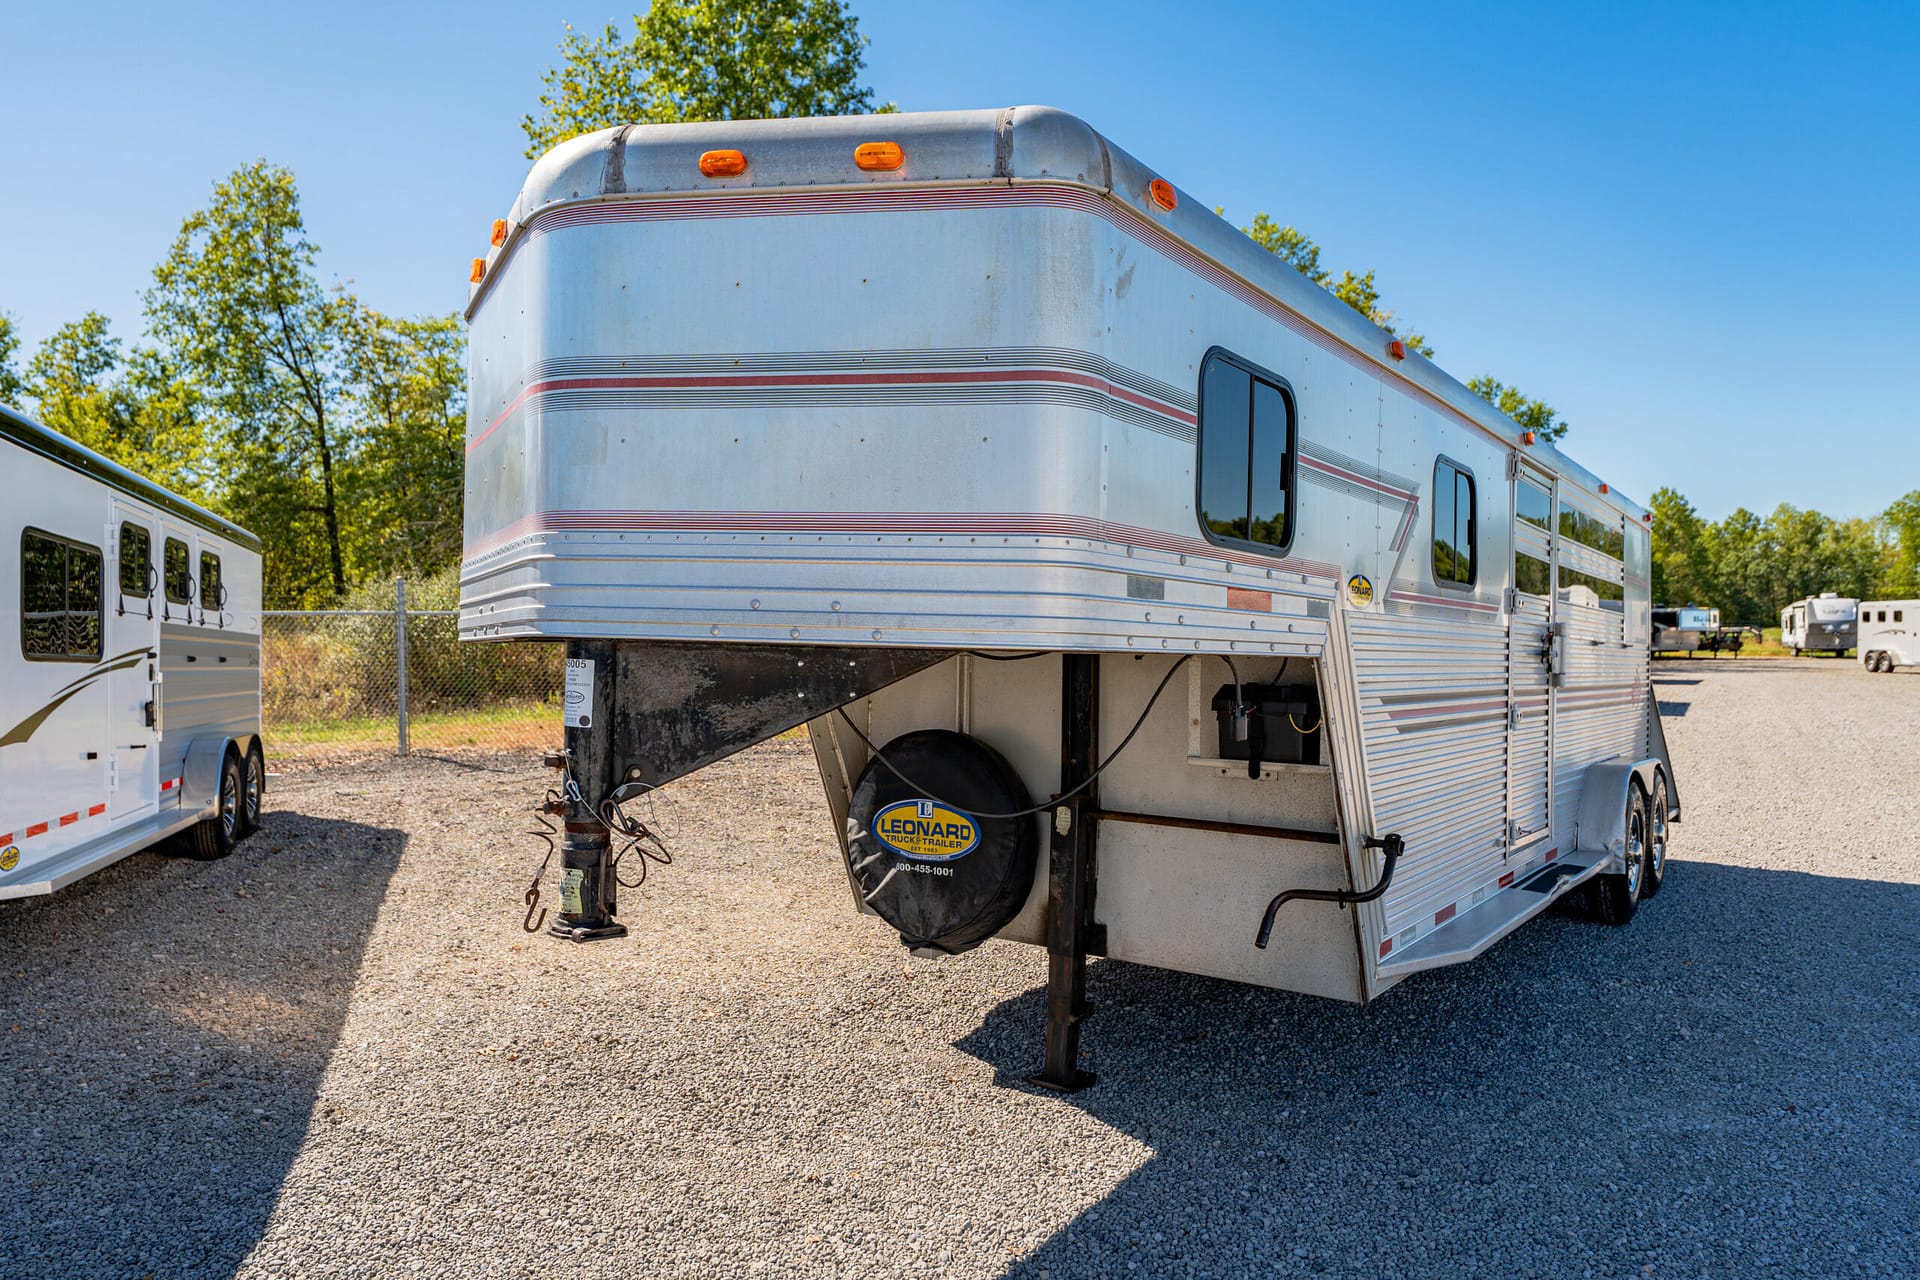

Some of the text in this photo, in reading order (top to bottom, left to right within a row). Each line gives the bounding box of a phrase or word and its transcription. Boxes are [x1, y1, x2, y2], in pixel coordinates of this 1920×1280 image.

[881, 818, 971, 841] LEONARD
[886, 834, 915, 844] TRUCK
[923, 838, 962, 849] TRAILER
[896, 862, 953, 877] 800-455-1001
